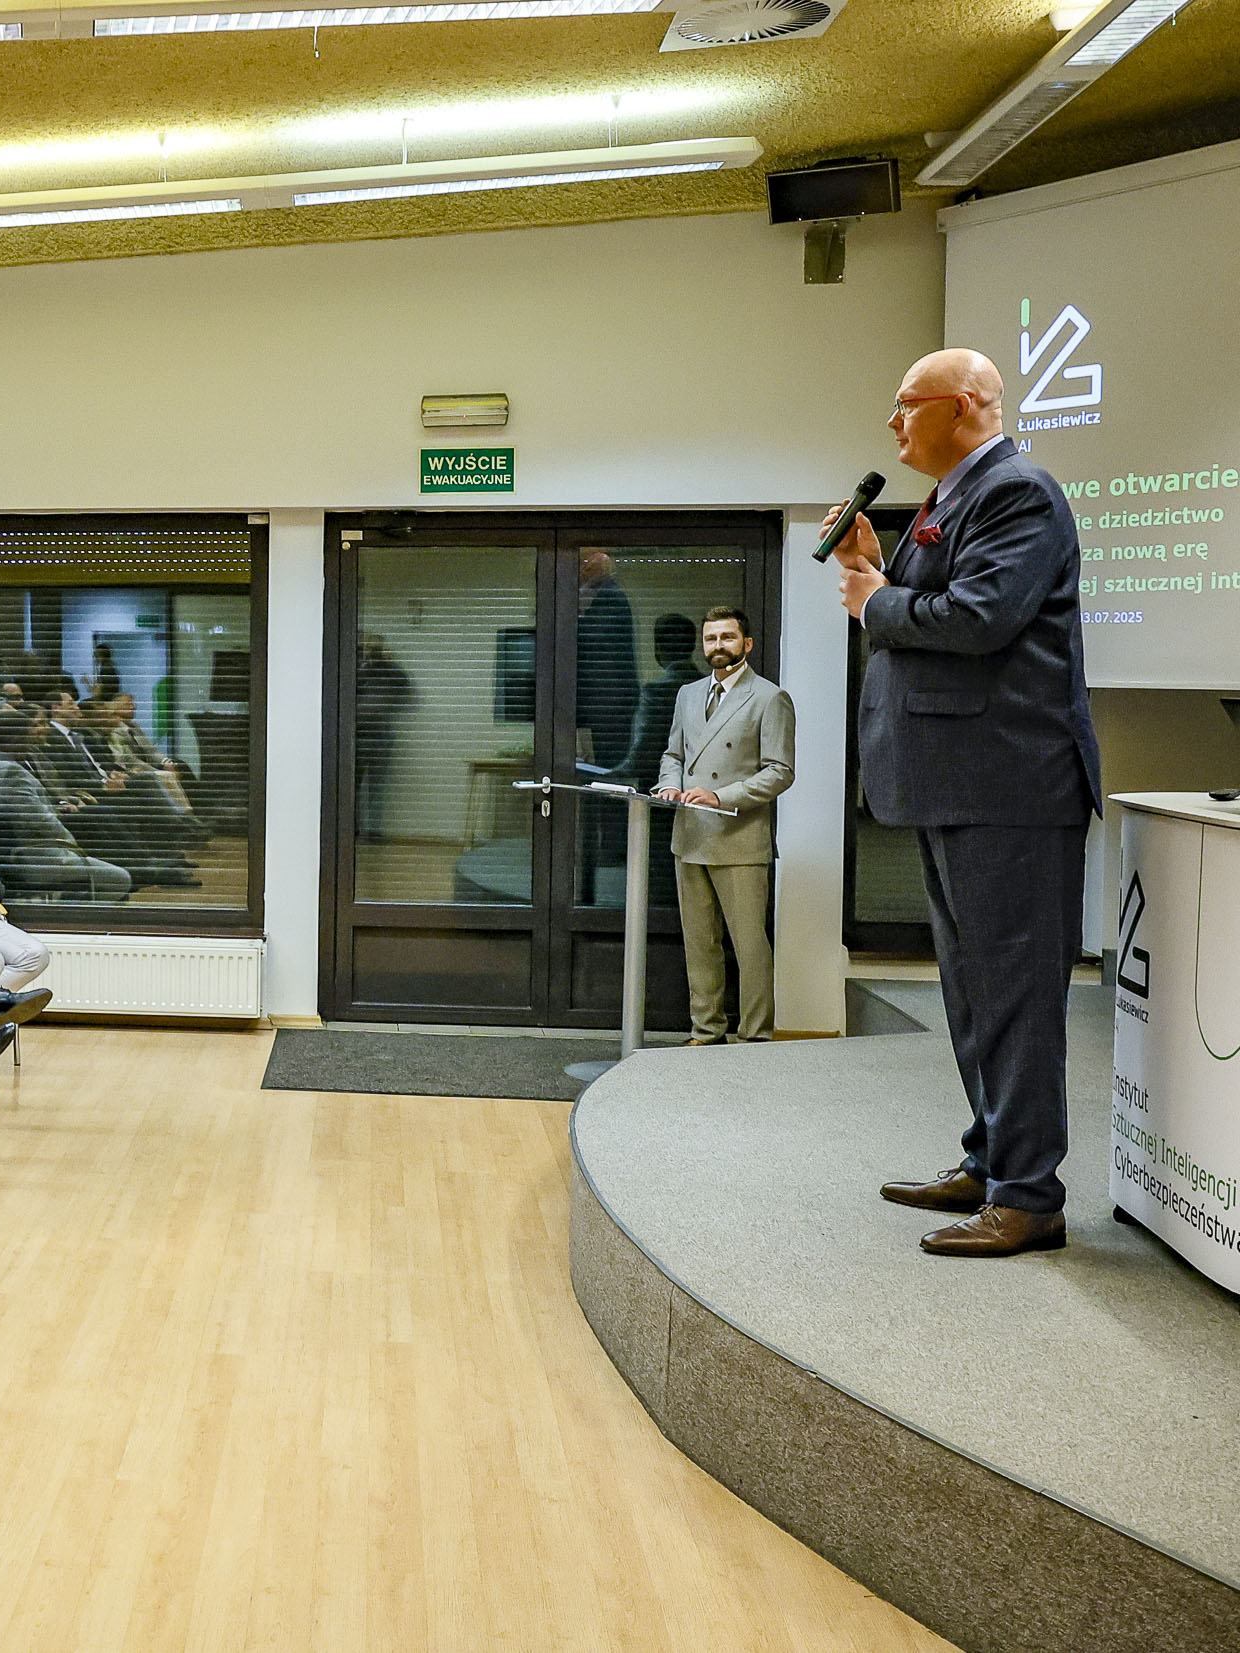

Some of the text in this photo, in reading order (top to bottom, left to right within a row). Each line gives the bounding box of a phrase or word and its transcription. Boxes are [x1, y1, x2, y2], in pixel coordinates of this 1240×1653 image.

[1017, 411, 1101, 432] Łukasiewicz
[1017, 439, 1032, 453] AI
[427, 453, 507, 471] WYJŚCIE
[423, 474, 512, 486] EWAKUACYJNE
[1061, 463, 1239, 500] we otwarcie
[1075, 506, 1224, 530] ie dziedzictwo
[1081, 542, 1209, 562] za nową erę
[1078, 571, 1240, 597] ej sztucznej int
[1113, 1068, 1149, 1114] nstytut
[1160, 1137, 1237, 1211] Inteligencji
